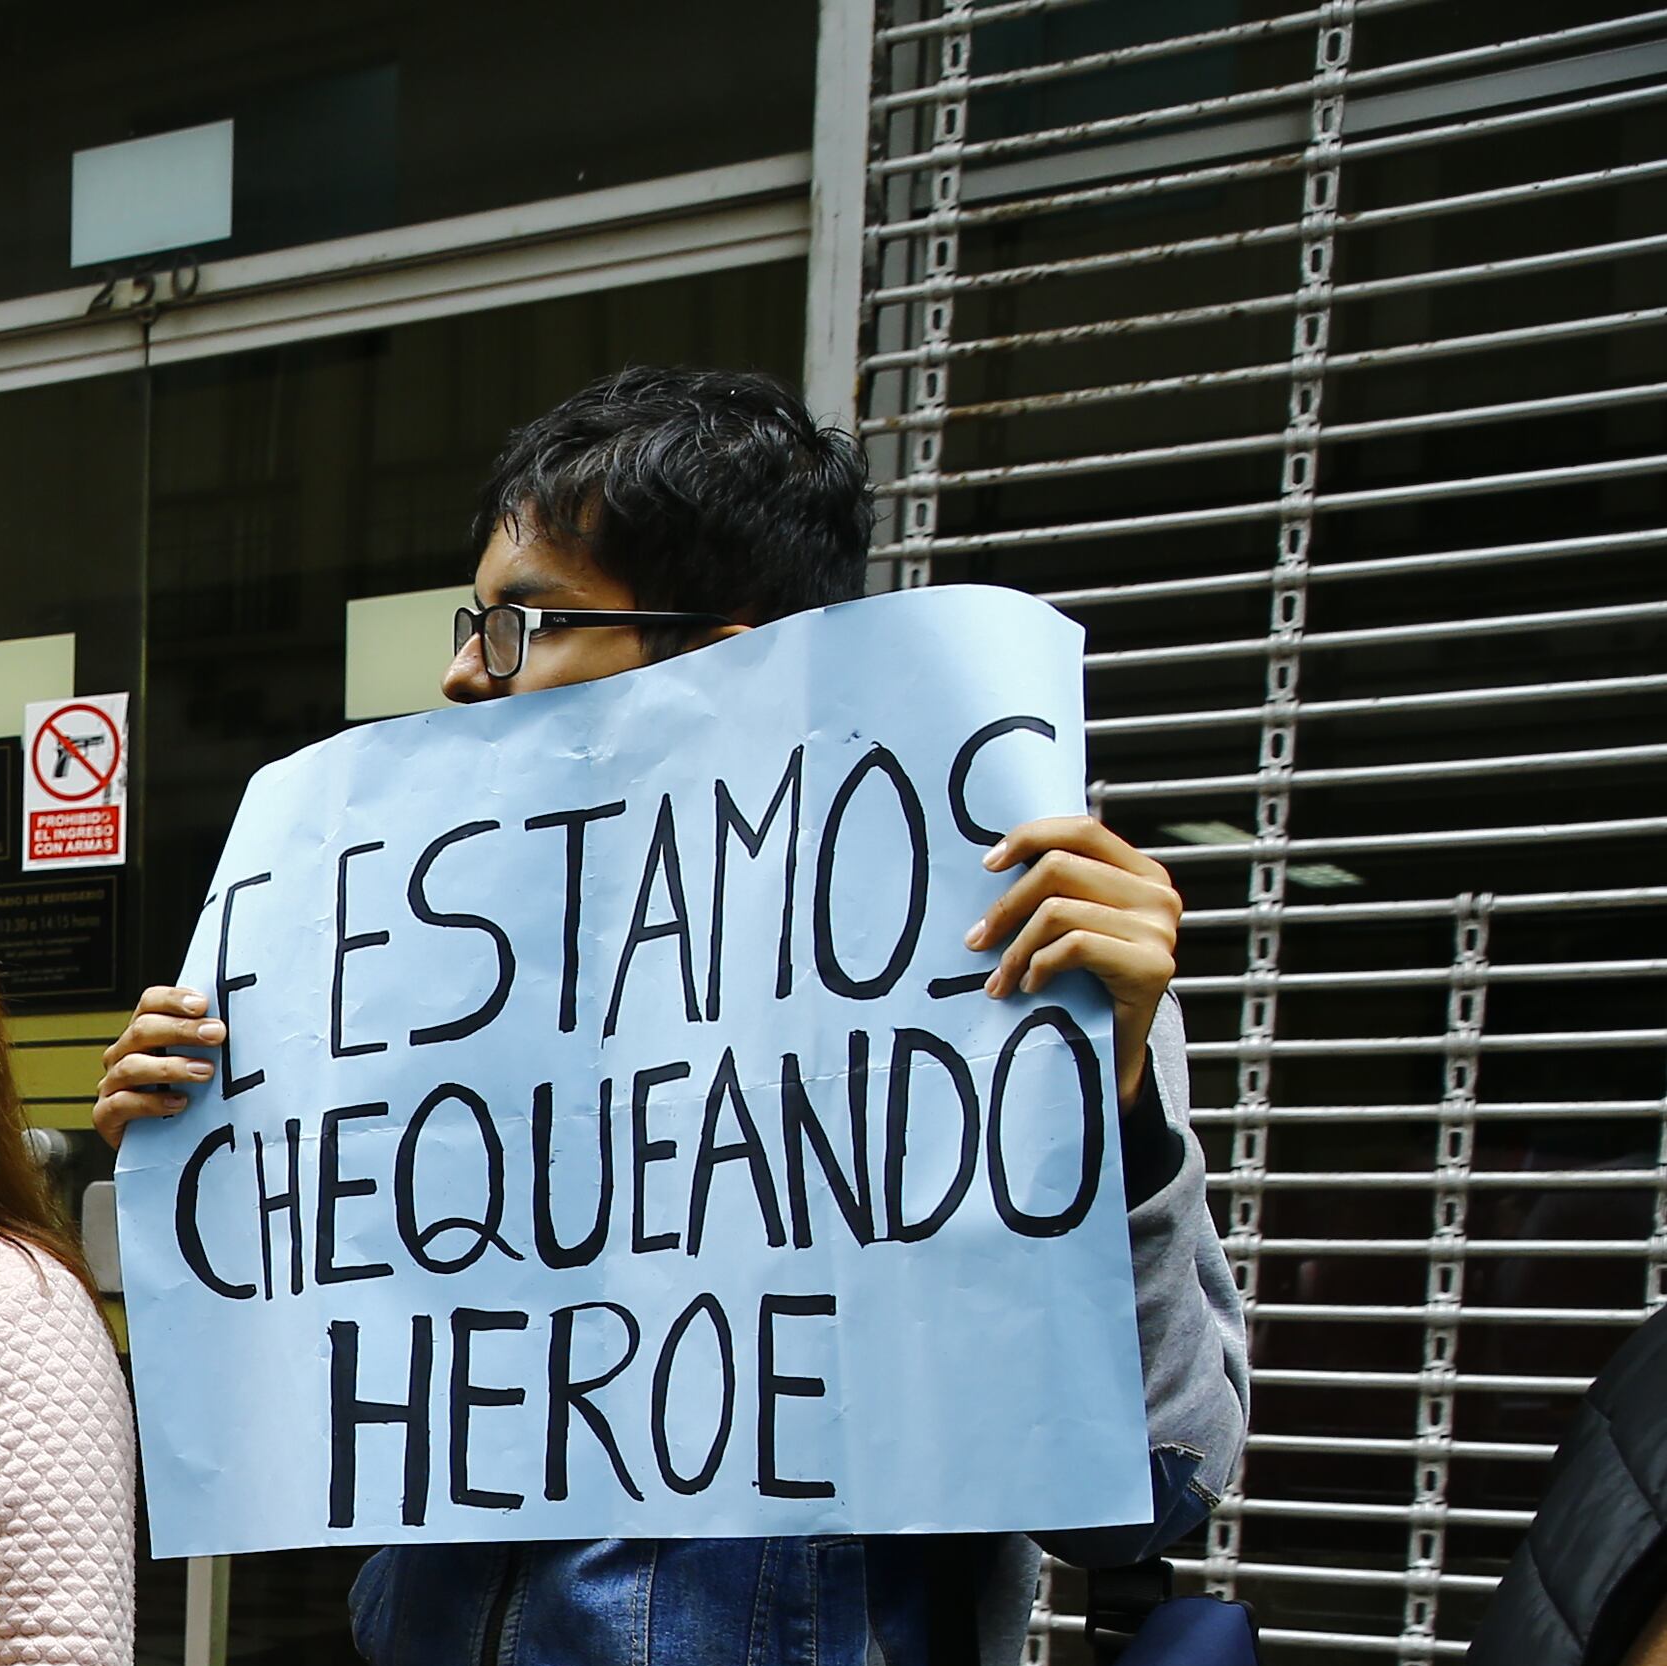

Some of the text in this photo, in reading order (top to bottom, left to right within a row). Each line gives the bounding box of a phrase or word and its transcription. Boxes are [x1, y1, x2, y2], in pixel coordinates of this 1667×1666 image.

[34, 824, 115, 842] EL INGRESO
[34, 838, 113, 856] CON ARMAS
[37, 811, 111, 828] PROHIBIDO
[330, 717, 1055, 1058] ESTAMOS
[175, 1004, 1105, 1302] CHEQUEANDO
[327, 1292, 837, 1530] HEROE
